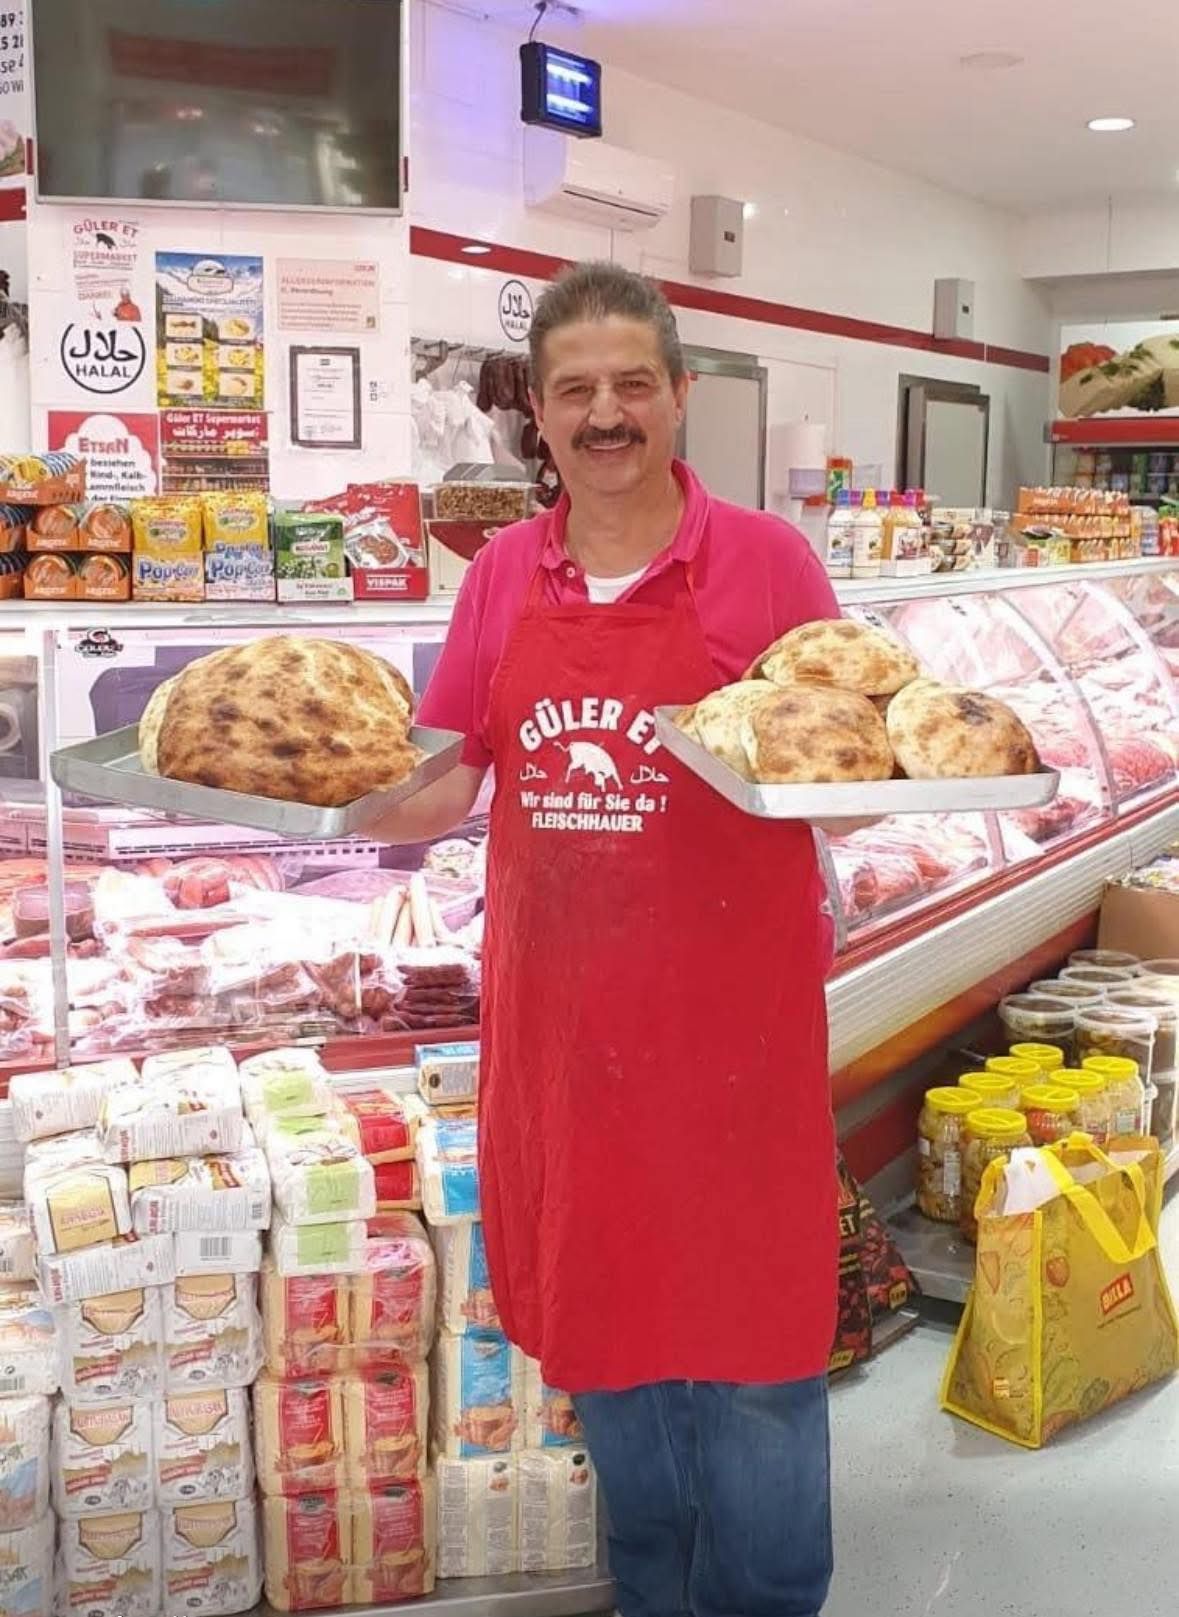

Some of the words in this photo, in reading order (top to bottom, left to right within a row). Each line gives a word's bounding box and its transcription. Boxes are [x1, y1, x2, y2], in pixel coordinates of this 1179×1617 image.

[74, 219, 118, 234] GÜLER
[123, 225, 139, 238] ET
[502, 293, 530, 319] حلال
[69, 329, 138, 362] حلال
[76, 364, 131, 379] HALAL
[519, 697, 624, 752] GÜLER
[521, 791, 542, 808] Wir
[543, 792, 574, 809] sind
[577, 792, 602, 810] für
[605, 793, 631, 811] Sie
[635, 794, 656, 812] da
[532, 812, 645, 832] FLEISCHHAUER
